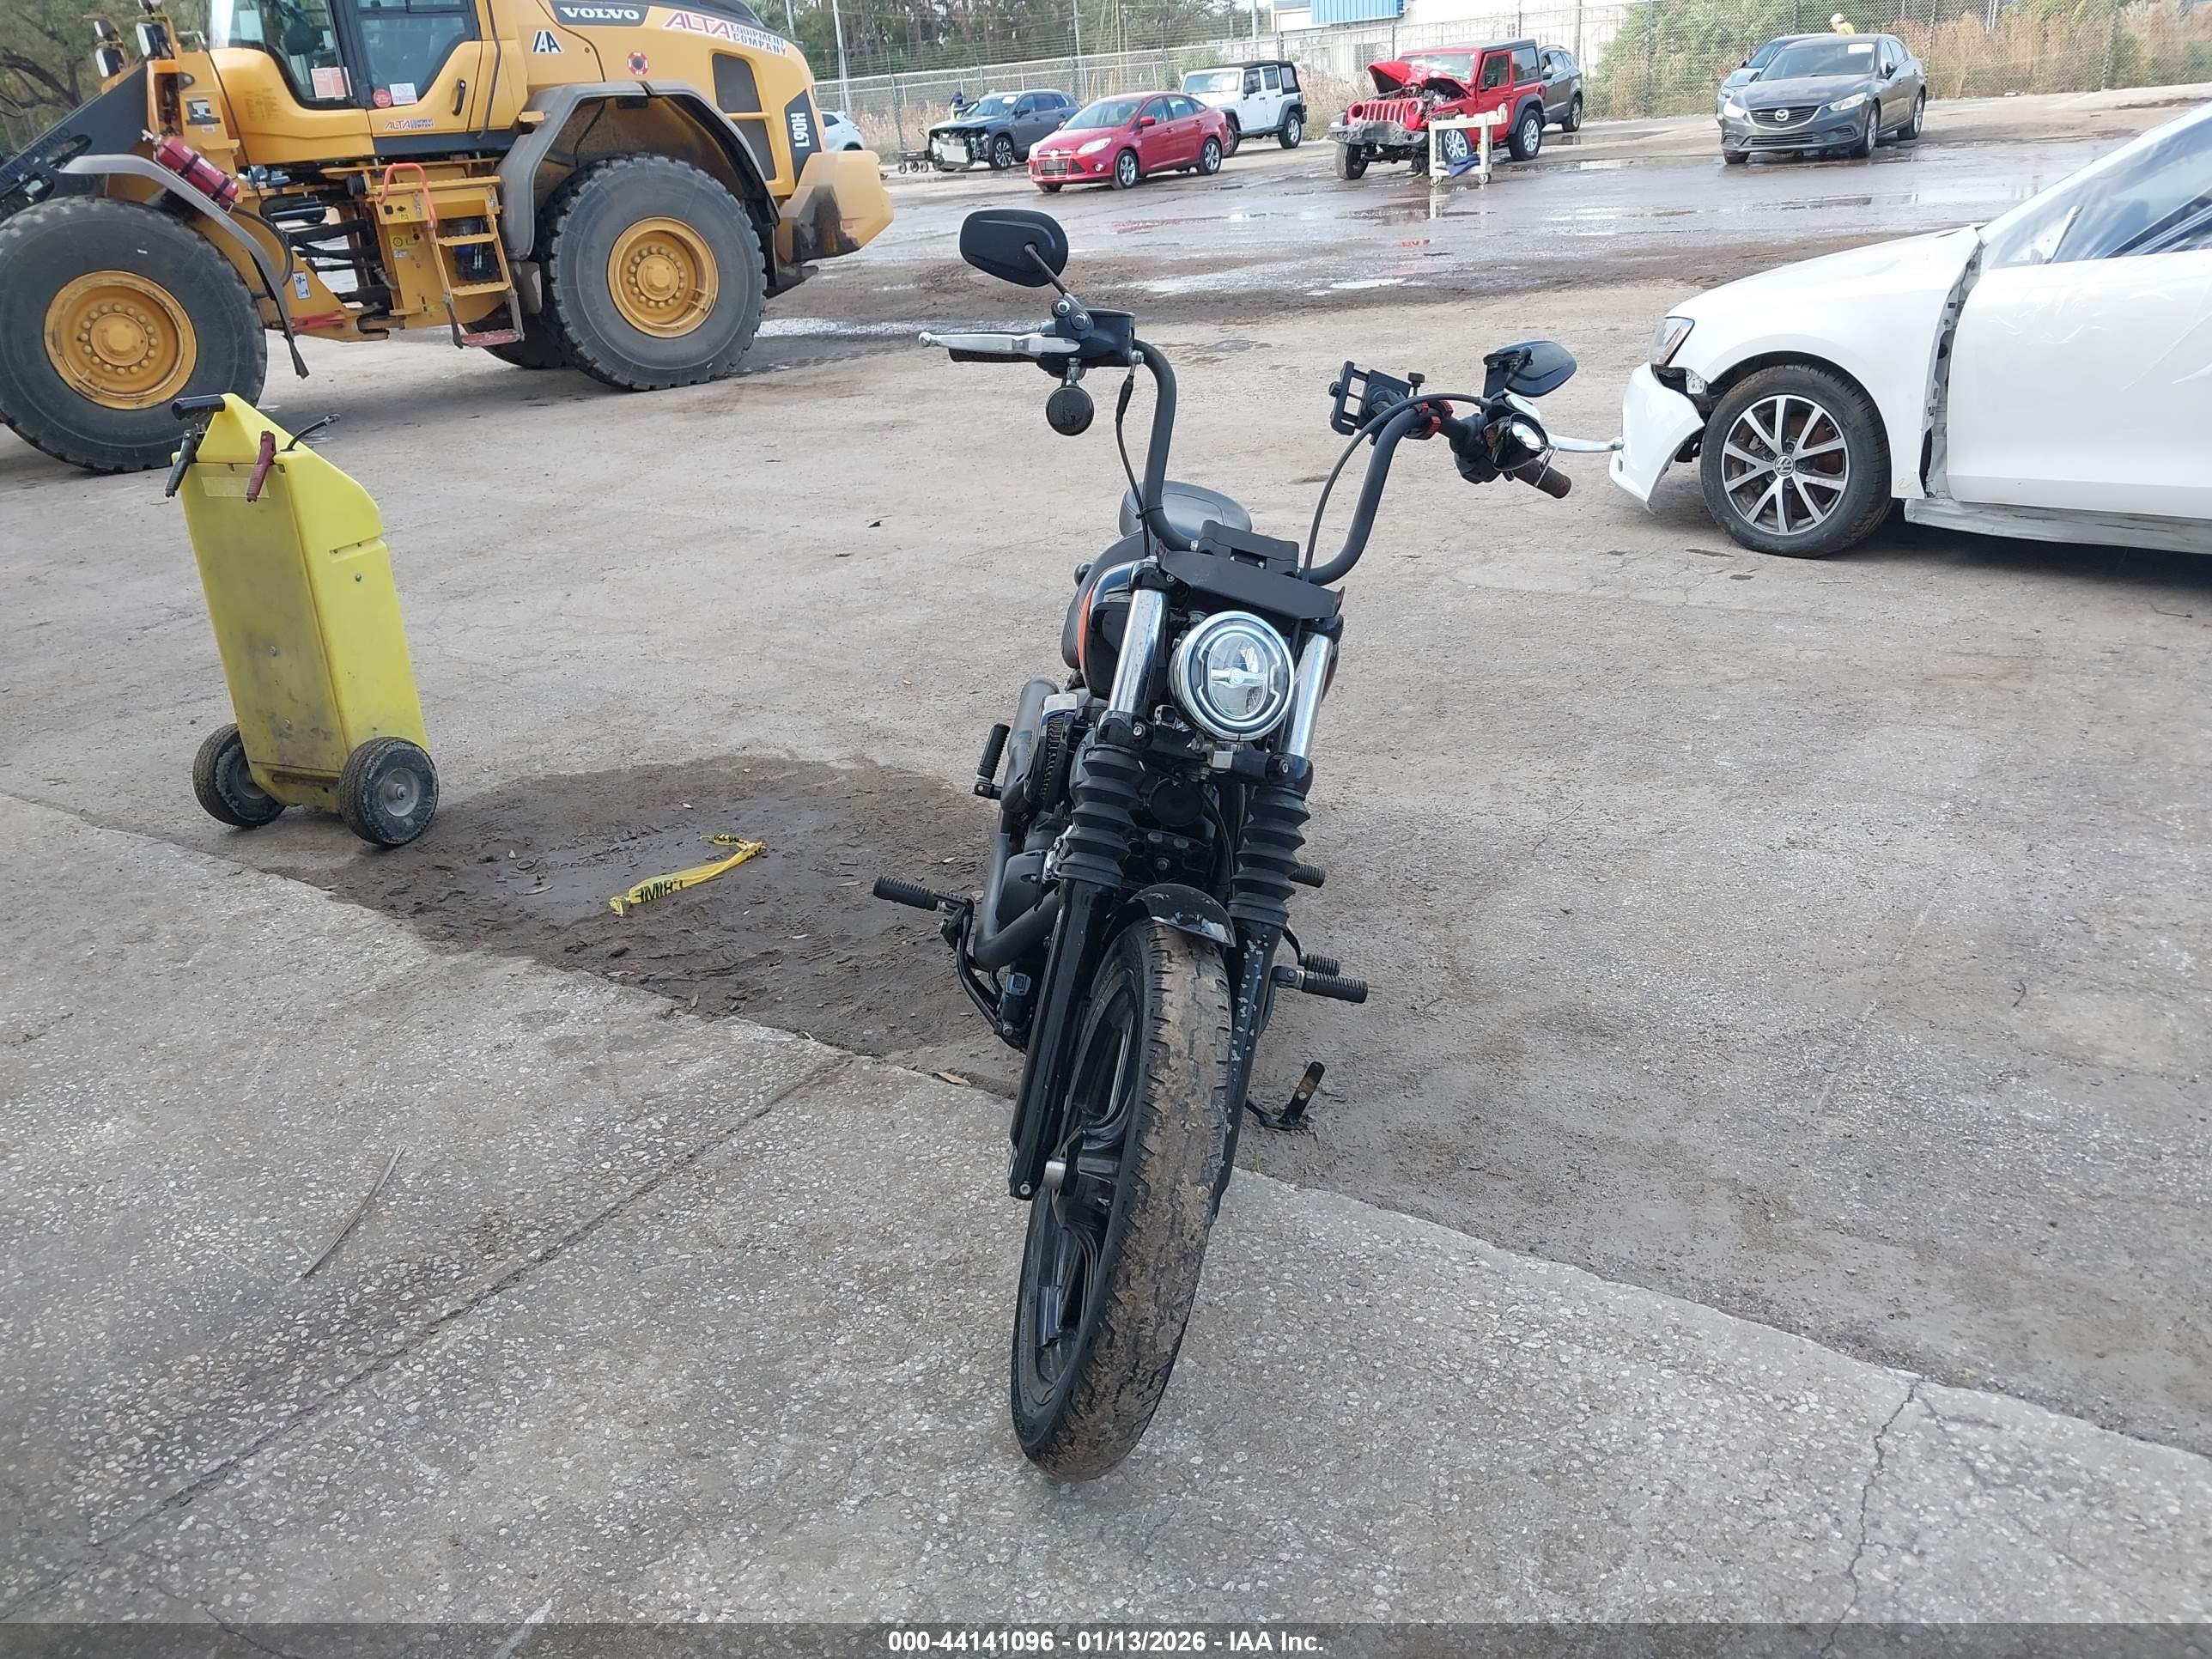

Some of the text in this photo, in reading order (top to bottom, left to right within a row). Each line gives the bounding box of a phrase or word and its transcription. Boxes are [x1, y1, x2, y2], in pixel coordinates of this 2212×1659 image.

[560, 7, 640, 20] VOLVO
[665, 12, 784, 46] ALTA EQUIPMENT
[733, 33, 786, 55] COMPANY
[385, 119, 412, 130] ALTA
[790, 112, 810, 147] L90H
